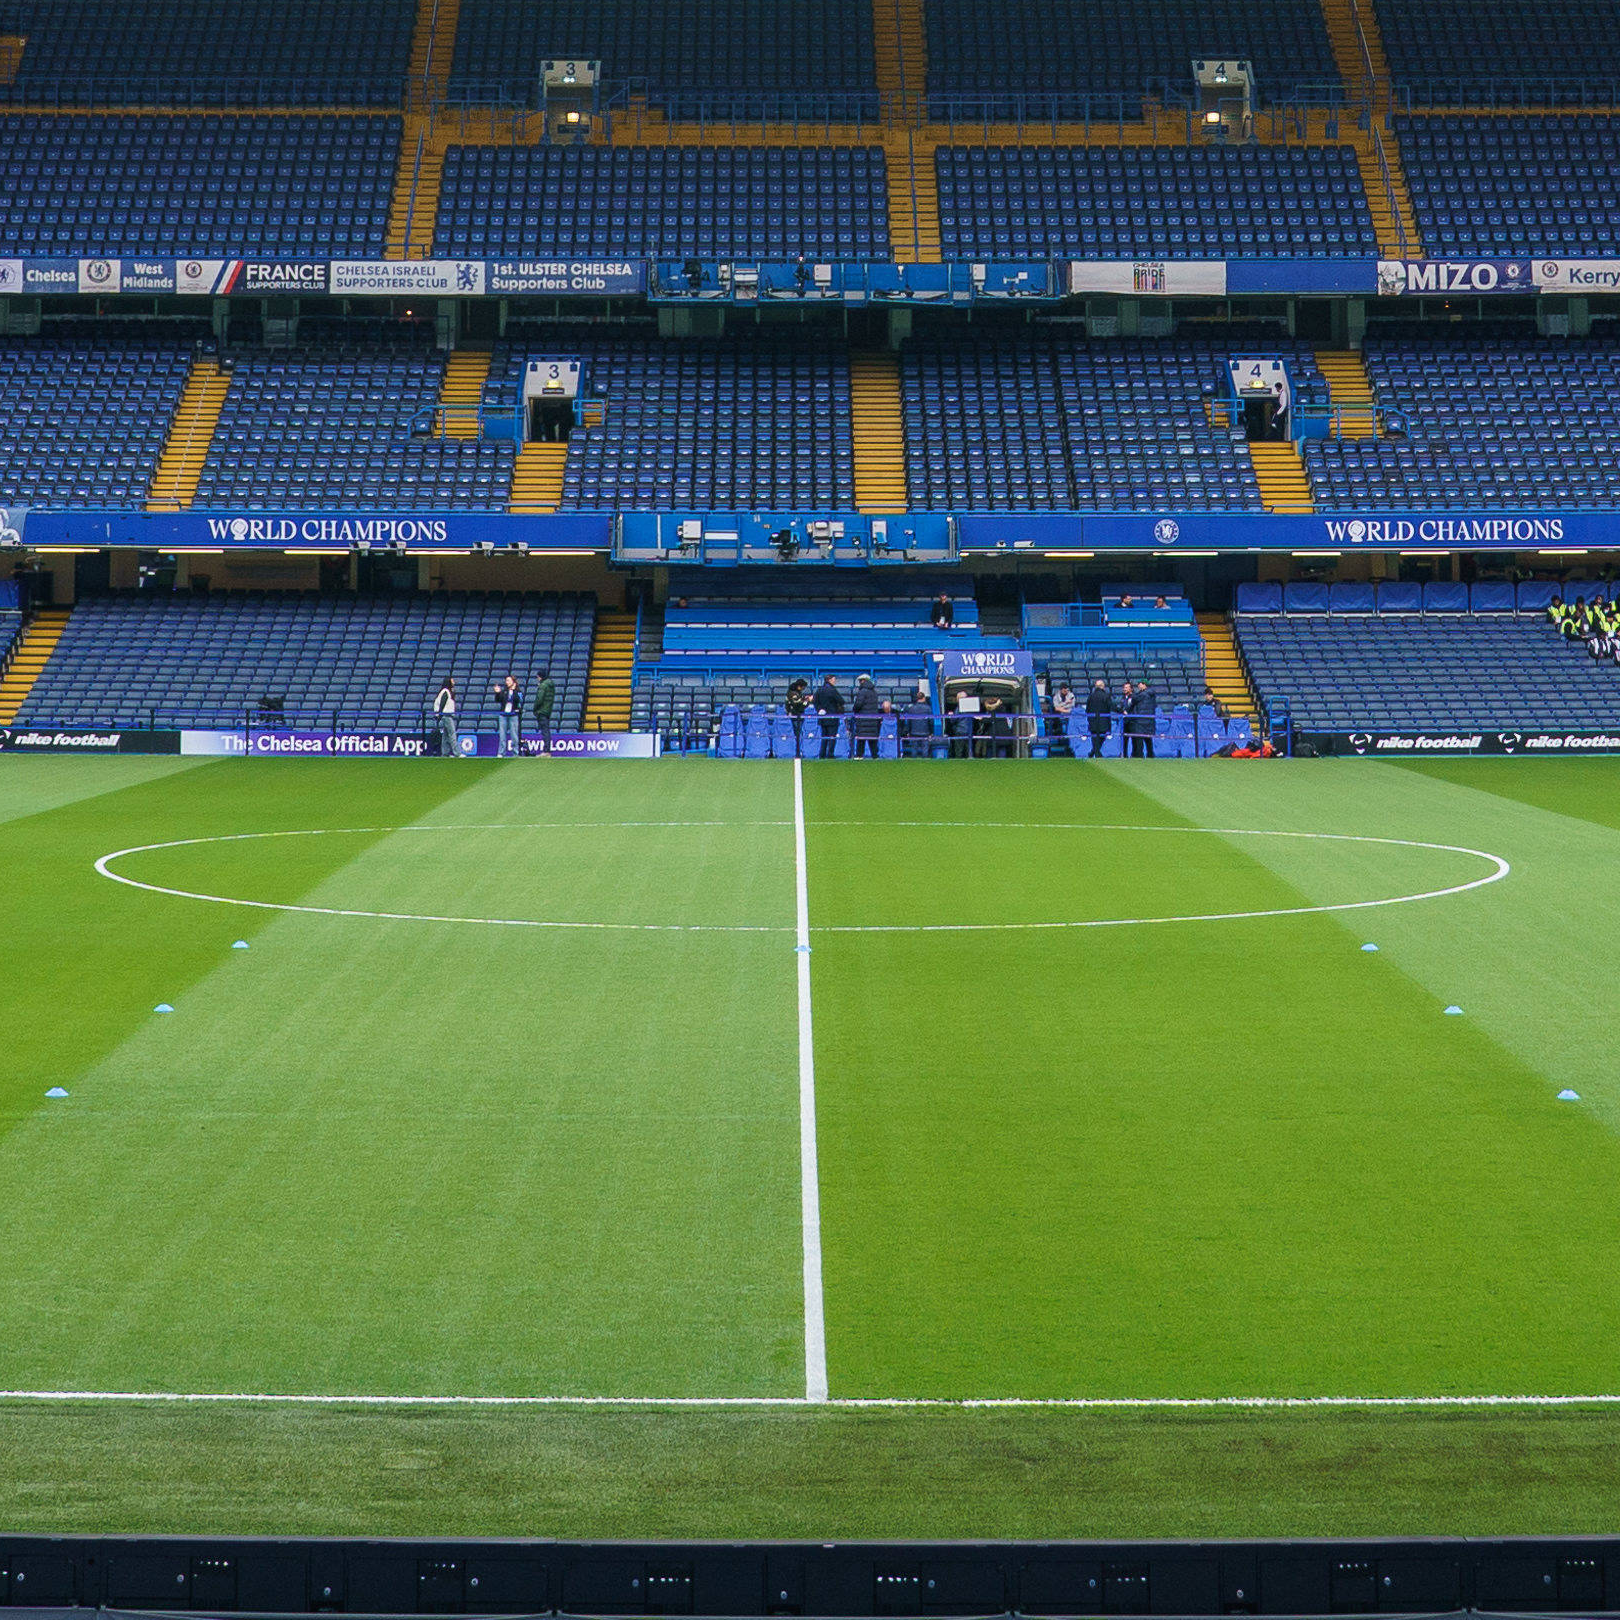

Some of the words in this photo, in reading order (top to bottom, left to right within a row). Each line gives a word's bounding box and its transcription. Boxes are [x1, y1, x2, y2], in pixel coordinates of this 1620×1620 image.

[565, 62, 575, 76] 3
[1215, 62, 1226, 76] 4
[133, 263, 163, 275] West
[246, 264, 325, 280] FRANCE
[336, 266, 389, 276] CHELSEA
[393, 266, 436, 276] ISRAELI
[493, 263, 517, 276] 1st.
[519, 263, 569, 276] ULSTER
[571, 263, 633, 276] CHELSEA
[26, 270, 76, 282] Chelsea
[123, 276, 174, 288] Midlands
[1408, 263, 1498, 291] MIZO
[1569, 268, 1620, 286] Kerry
[246, 281, 301, 290] SUPPORTERS
[302, 281, 325, 290] CLUB
[336, 278, 413, 288] SUPPORTERS
[416, 278, 448, 288] CLUB
[492, 276, 568, 291] Supporters
[571, 276, 606, 289] Club
[549, 364, 559, 379] 3
[1250, 363, 1261, 378] 4
[208, 518, 296, 540] WORLD
[302, 519, 447, 540] CHAMPIONS
[1325, 520, 1414, 542] WORLD
[1420, 519, 1564, 541] CHAMPIONS
[961, 652, 1015, 667] WORLD
[960, 666, 1015, 675] CHAMPIONS
[15, 733, 53, 745] nike
[52, 733, 121, 746] football
[221, 735, 254, 751] The
[257, 735, 322, 751] Chelsea
[326, 735, 388, 752] Official
[392, 737, 427, 756] App
[507, 739, 584, 751] DWLOAD
[587, 740, 620, 751] NOW
[1376, 736, 1414, 748] nike
[1414, 735, 1482, 748] football
[1525, 735, 1563, 747] nike
